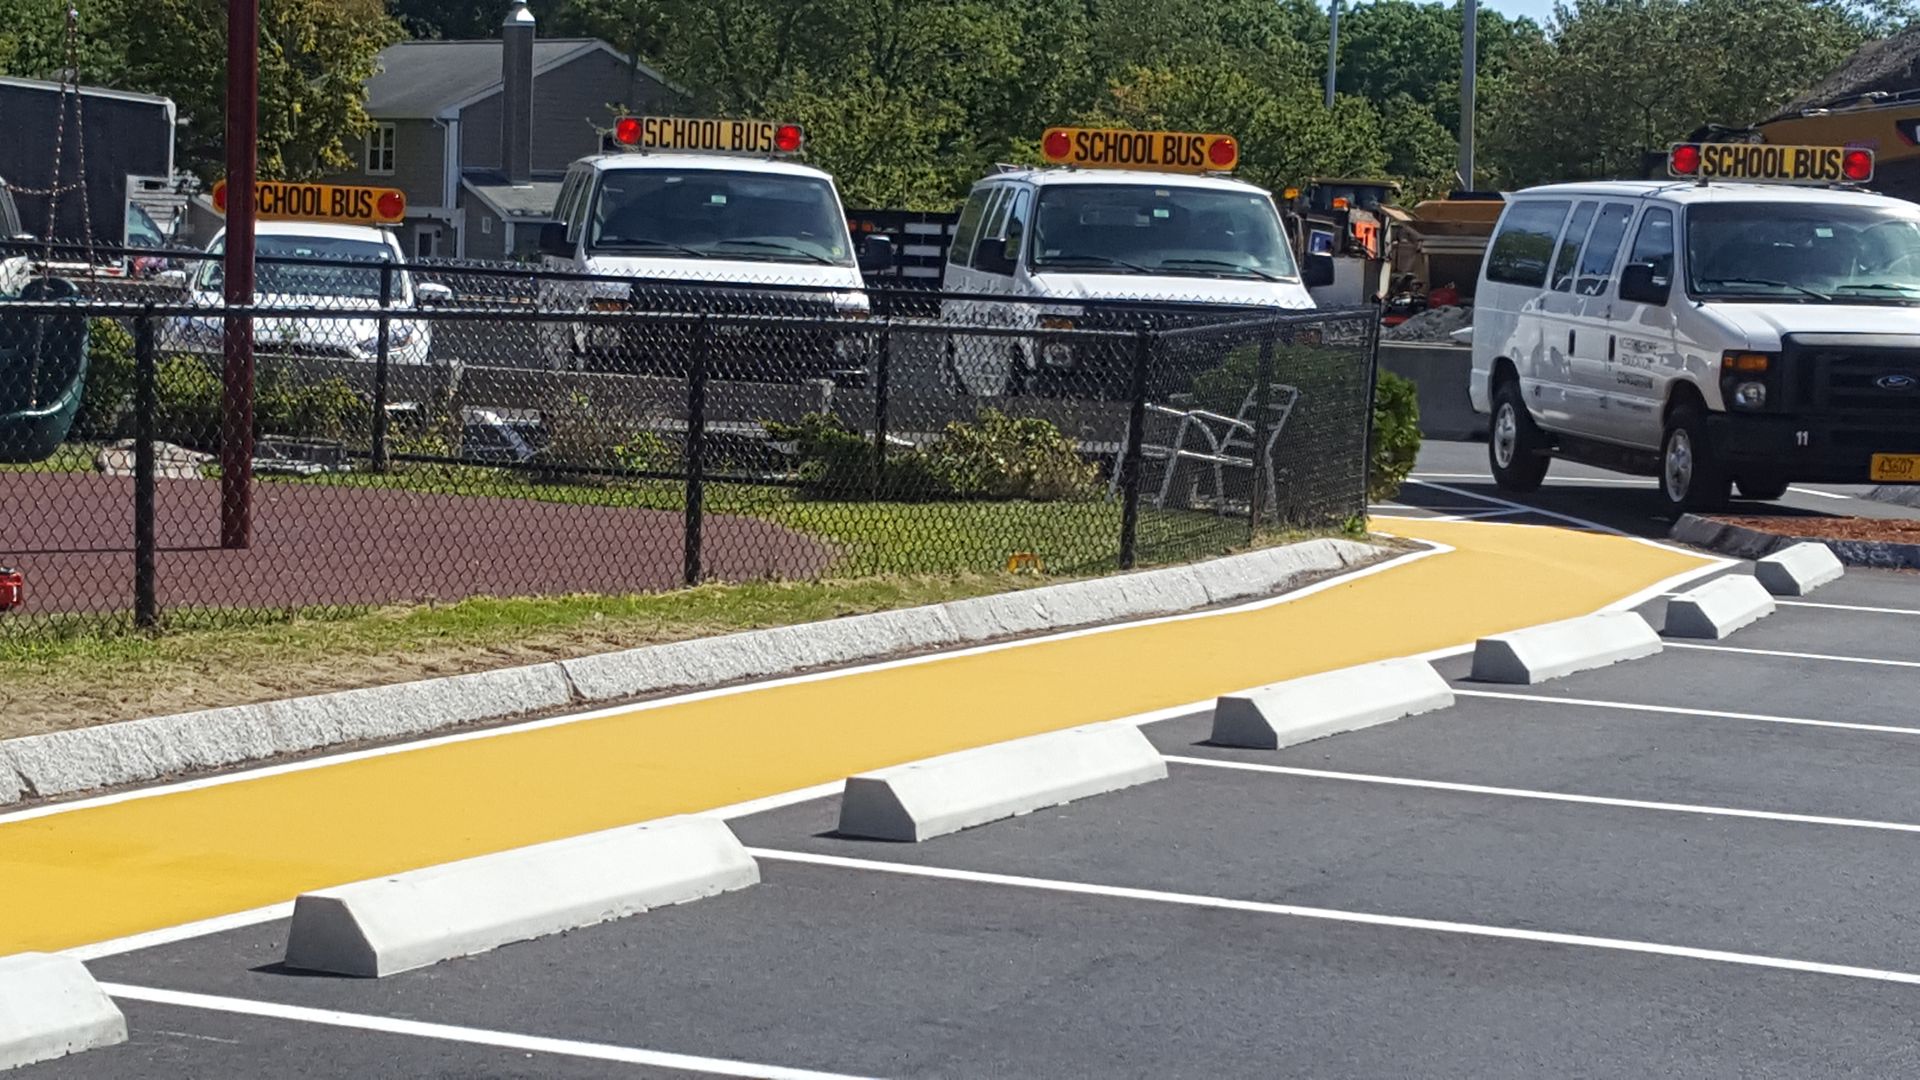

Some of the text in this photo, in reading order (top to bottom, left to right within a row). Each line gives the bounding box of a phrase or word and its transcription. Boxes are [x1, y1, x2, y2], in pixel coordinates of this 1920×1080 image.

[645, 118, 772, 152] SCHOOL BUS
[1075, 131, 1205, 166] SCHOOL BUS
[1703, 145, 1841, 179] SCHOOL BUS
[331, 188, 373, 218] BUS
[1796, 430, 1809, 446] 11
